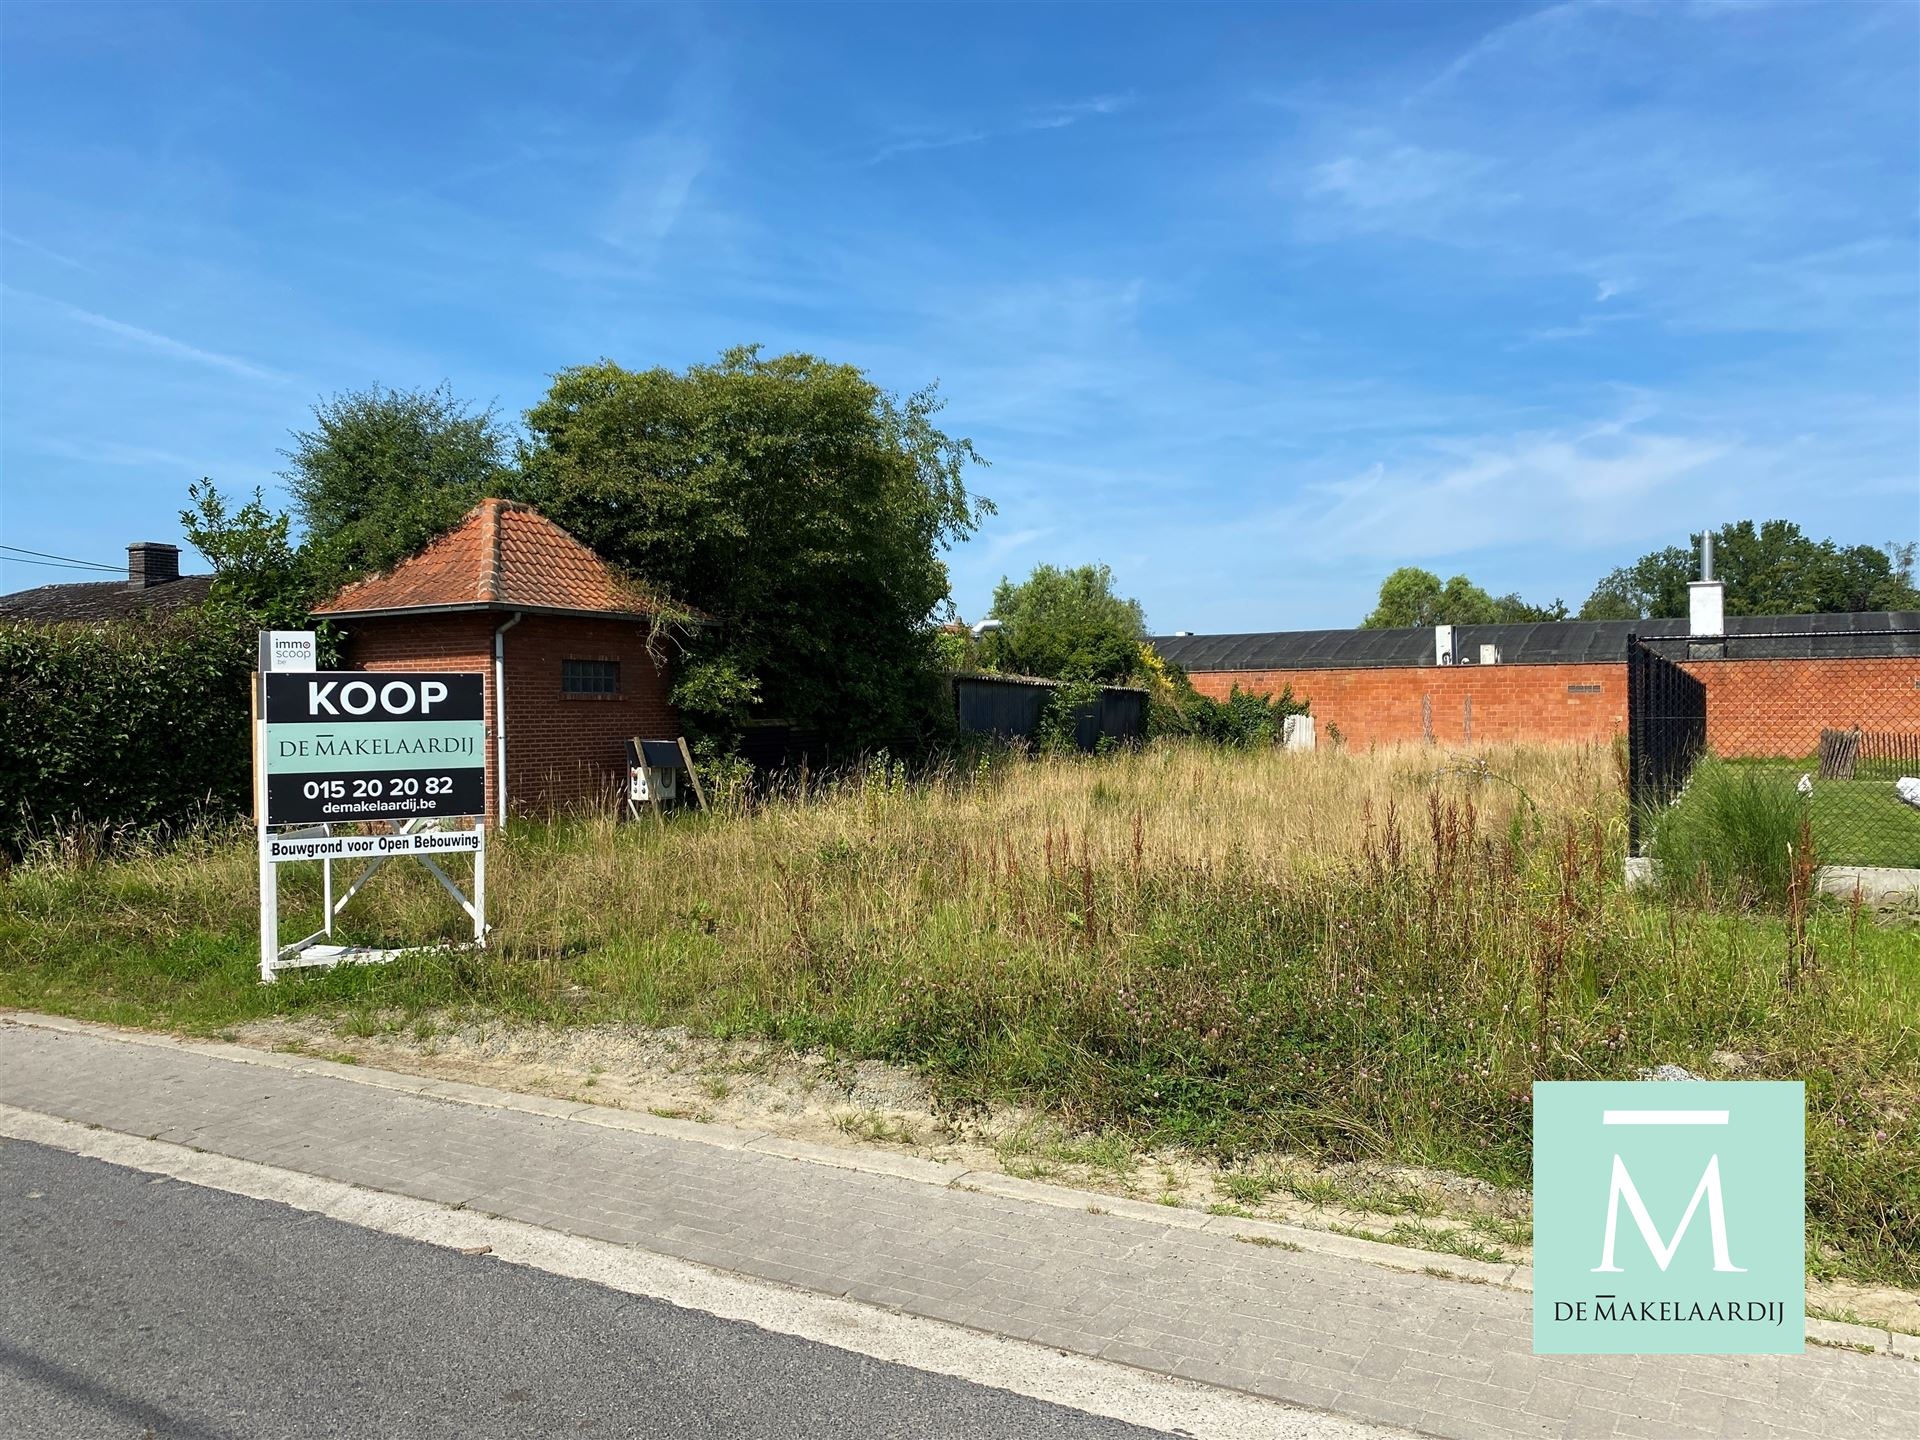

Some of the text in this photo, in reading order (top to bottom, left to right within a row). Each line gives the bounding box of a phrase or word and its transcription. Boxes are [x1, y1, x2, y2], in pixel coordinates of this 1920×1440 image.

[275, 639, 310, 649] immo
[275, 650, 311, 660] scoop
[308, 681, 448, 715] KOOP
[279, 734, 475, 757] DE MAKELAARDIJ
[303, 777, 453, 799] 015 20 20 82
[322, 799, 437, 814] demakelaardij.be
[272, 834, 479, 857] Bouwgrond voor Open Bebouwing
